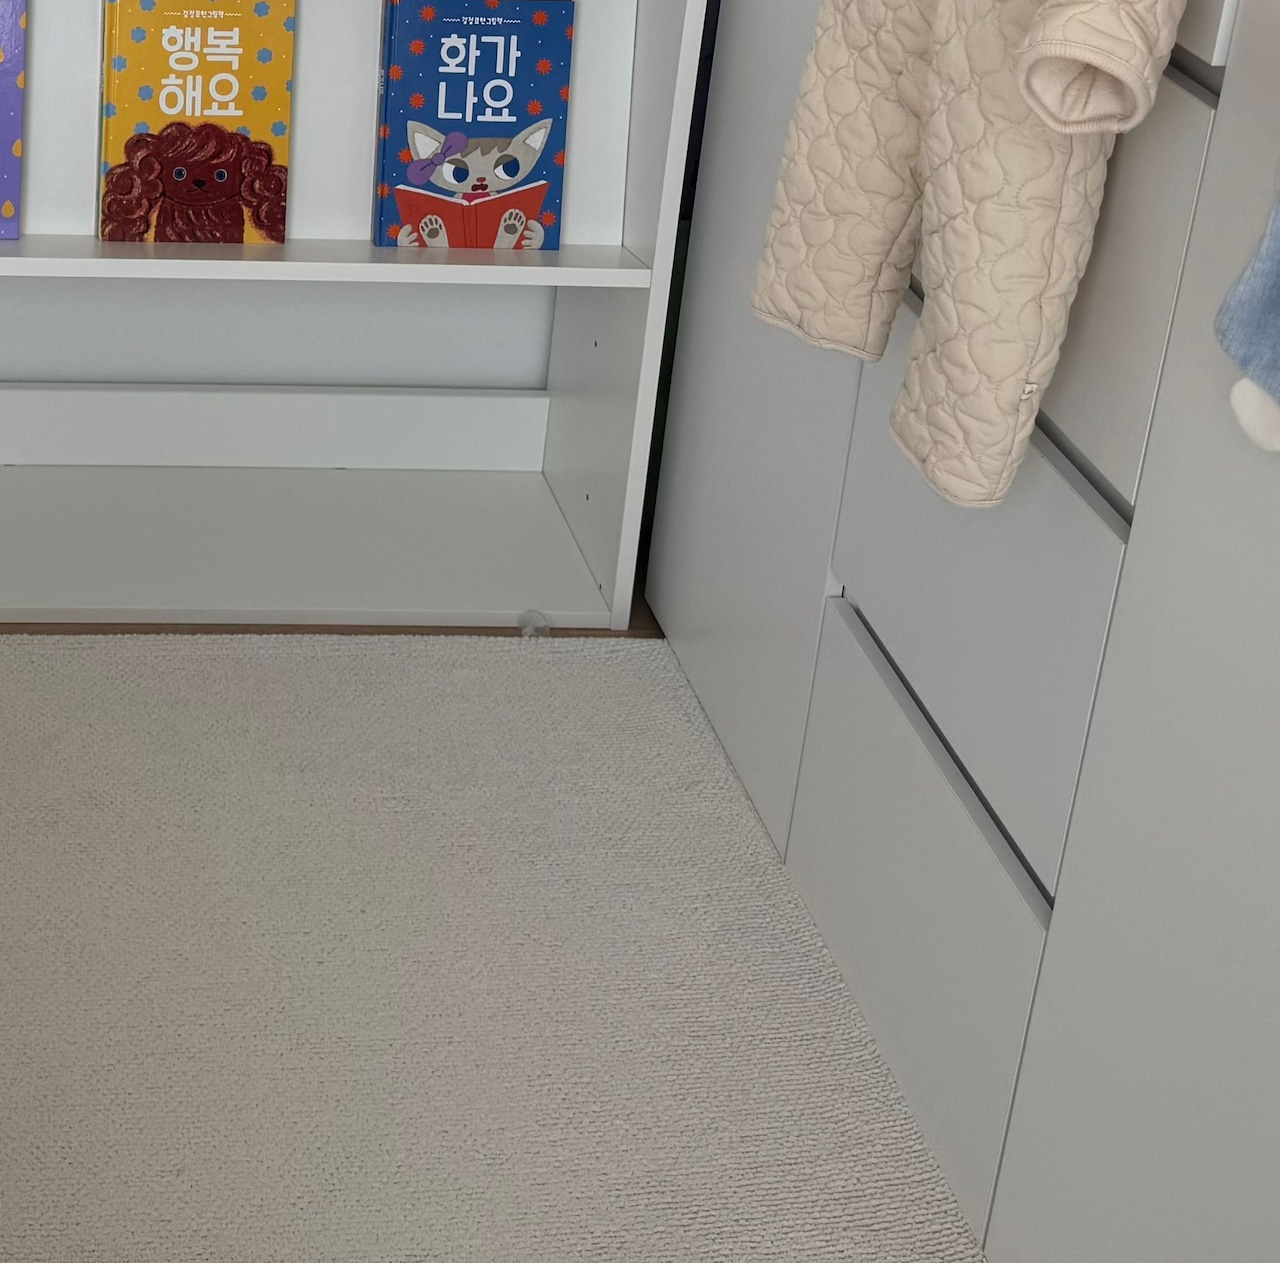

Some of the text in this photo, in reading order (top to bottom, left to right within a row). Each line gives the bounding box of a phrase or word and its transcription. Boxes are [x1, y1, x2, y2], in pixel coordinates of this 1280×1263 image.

[161, 25, 244, 71] 행복
[438, 33, 521, 77] 화가
[158, 72, 244, 117] 해요
[437, 78, 517, 123] 나요
